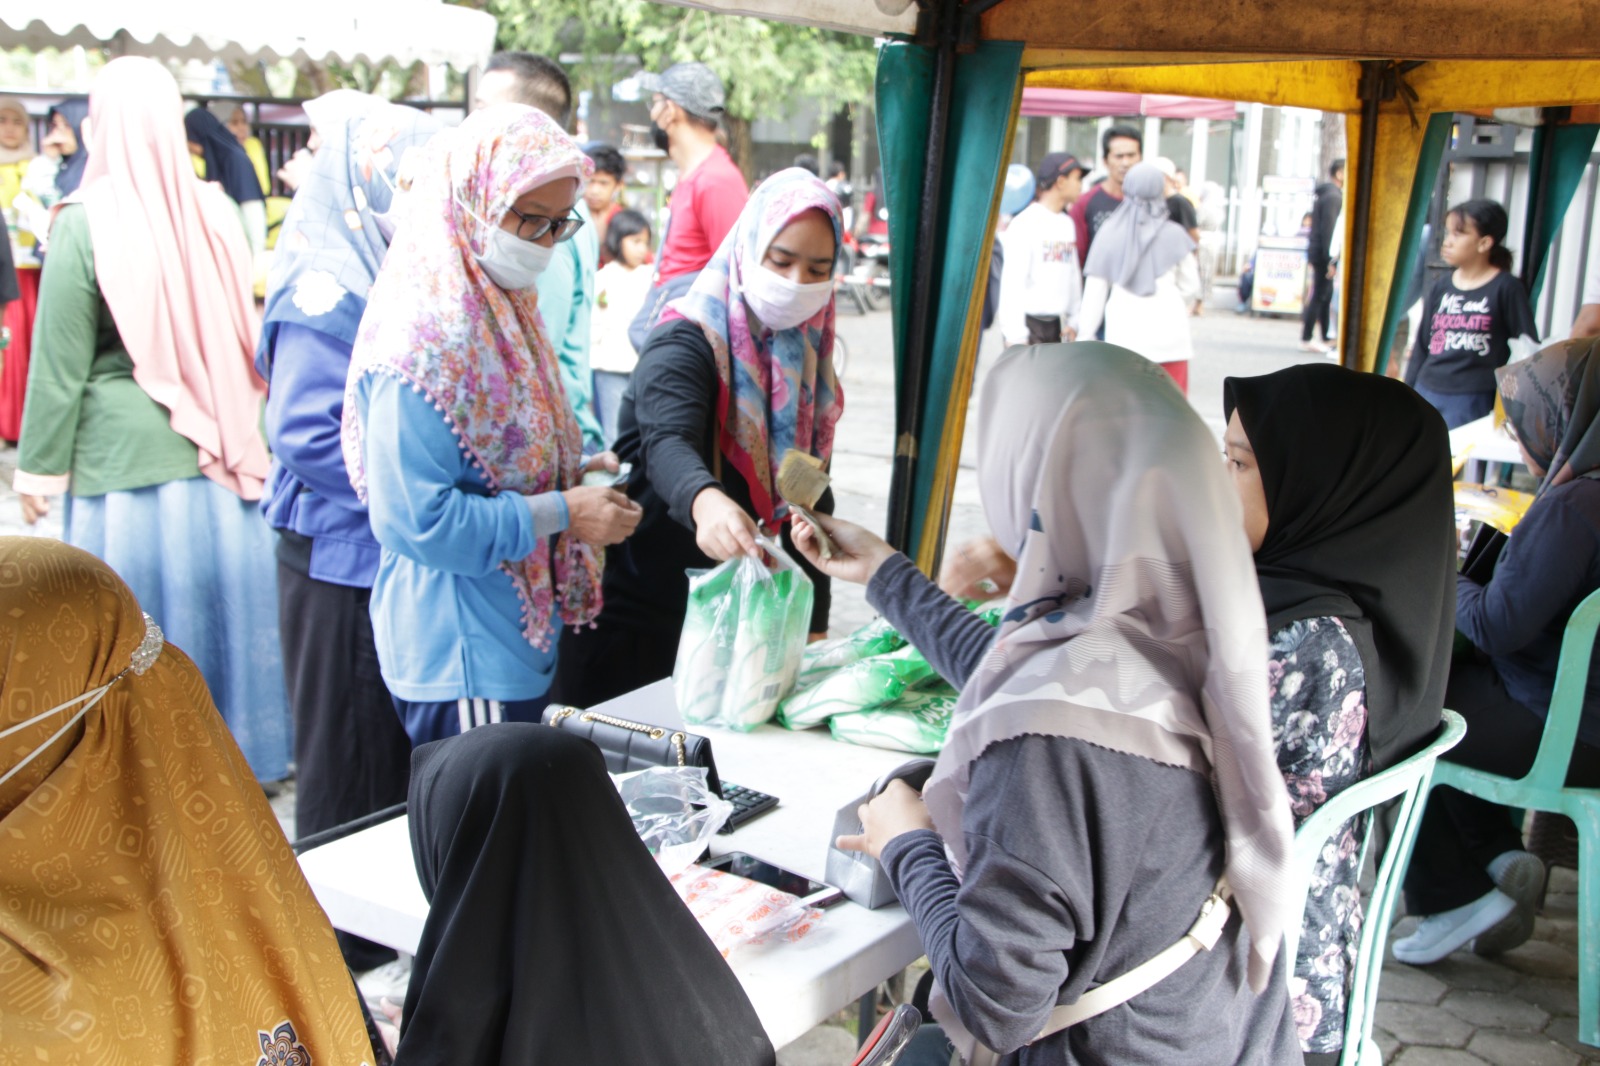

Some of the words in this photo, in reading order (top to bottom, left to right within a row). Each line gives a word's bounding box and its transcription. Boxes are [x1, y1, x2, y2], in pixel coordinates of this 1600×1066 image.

[1438, 292, 1464, 314] ME
[1462, 296, 1489, 313] and
[1428, 329, 1491, 356] PCAKES
[918, 697, 956, 724] PSM
